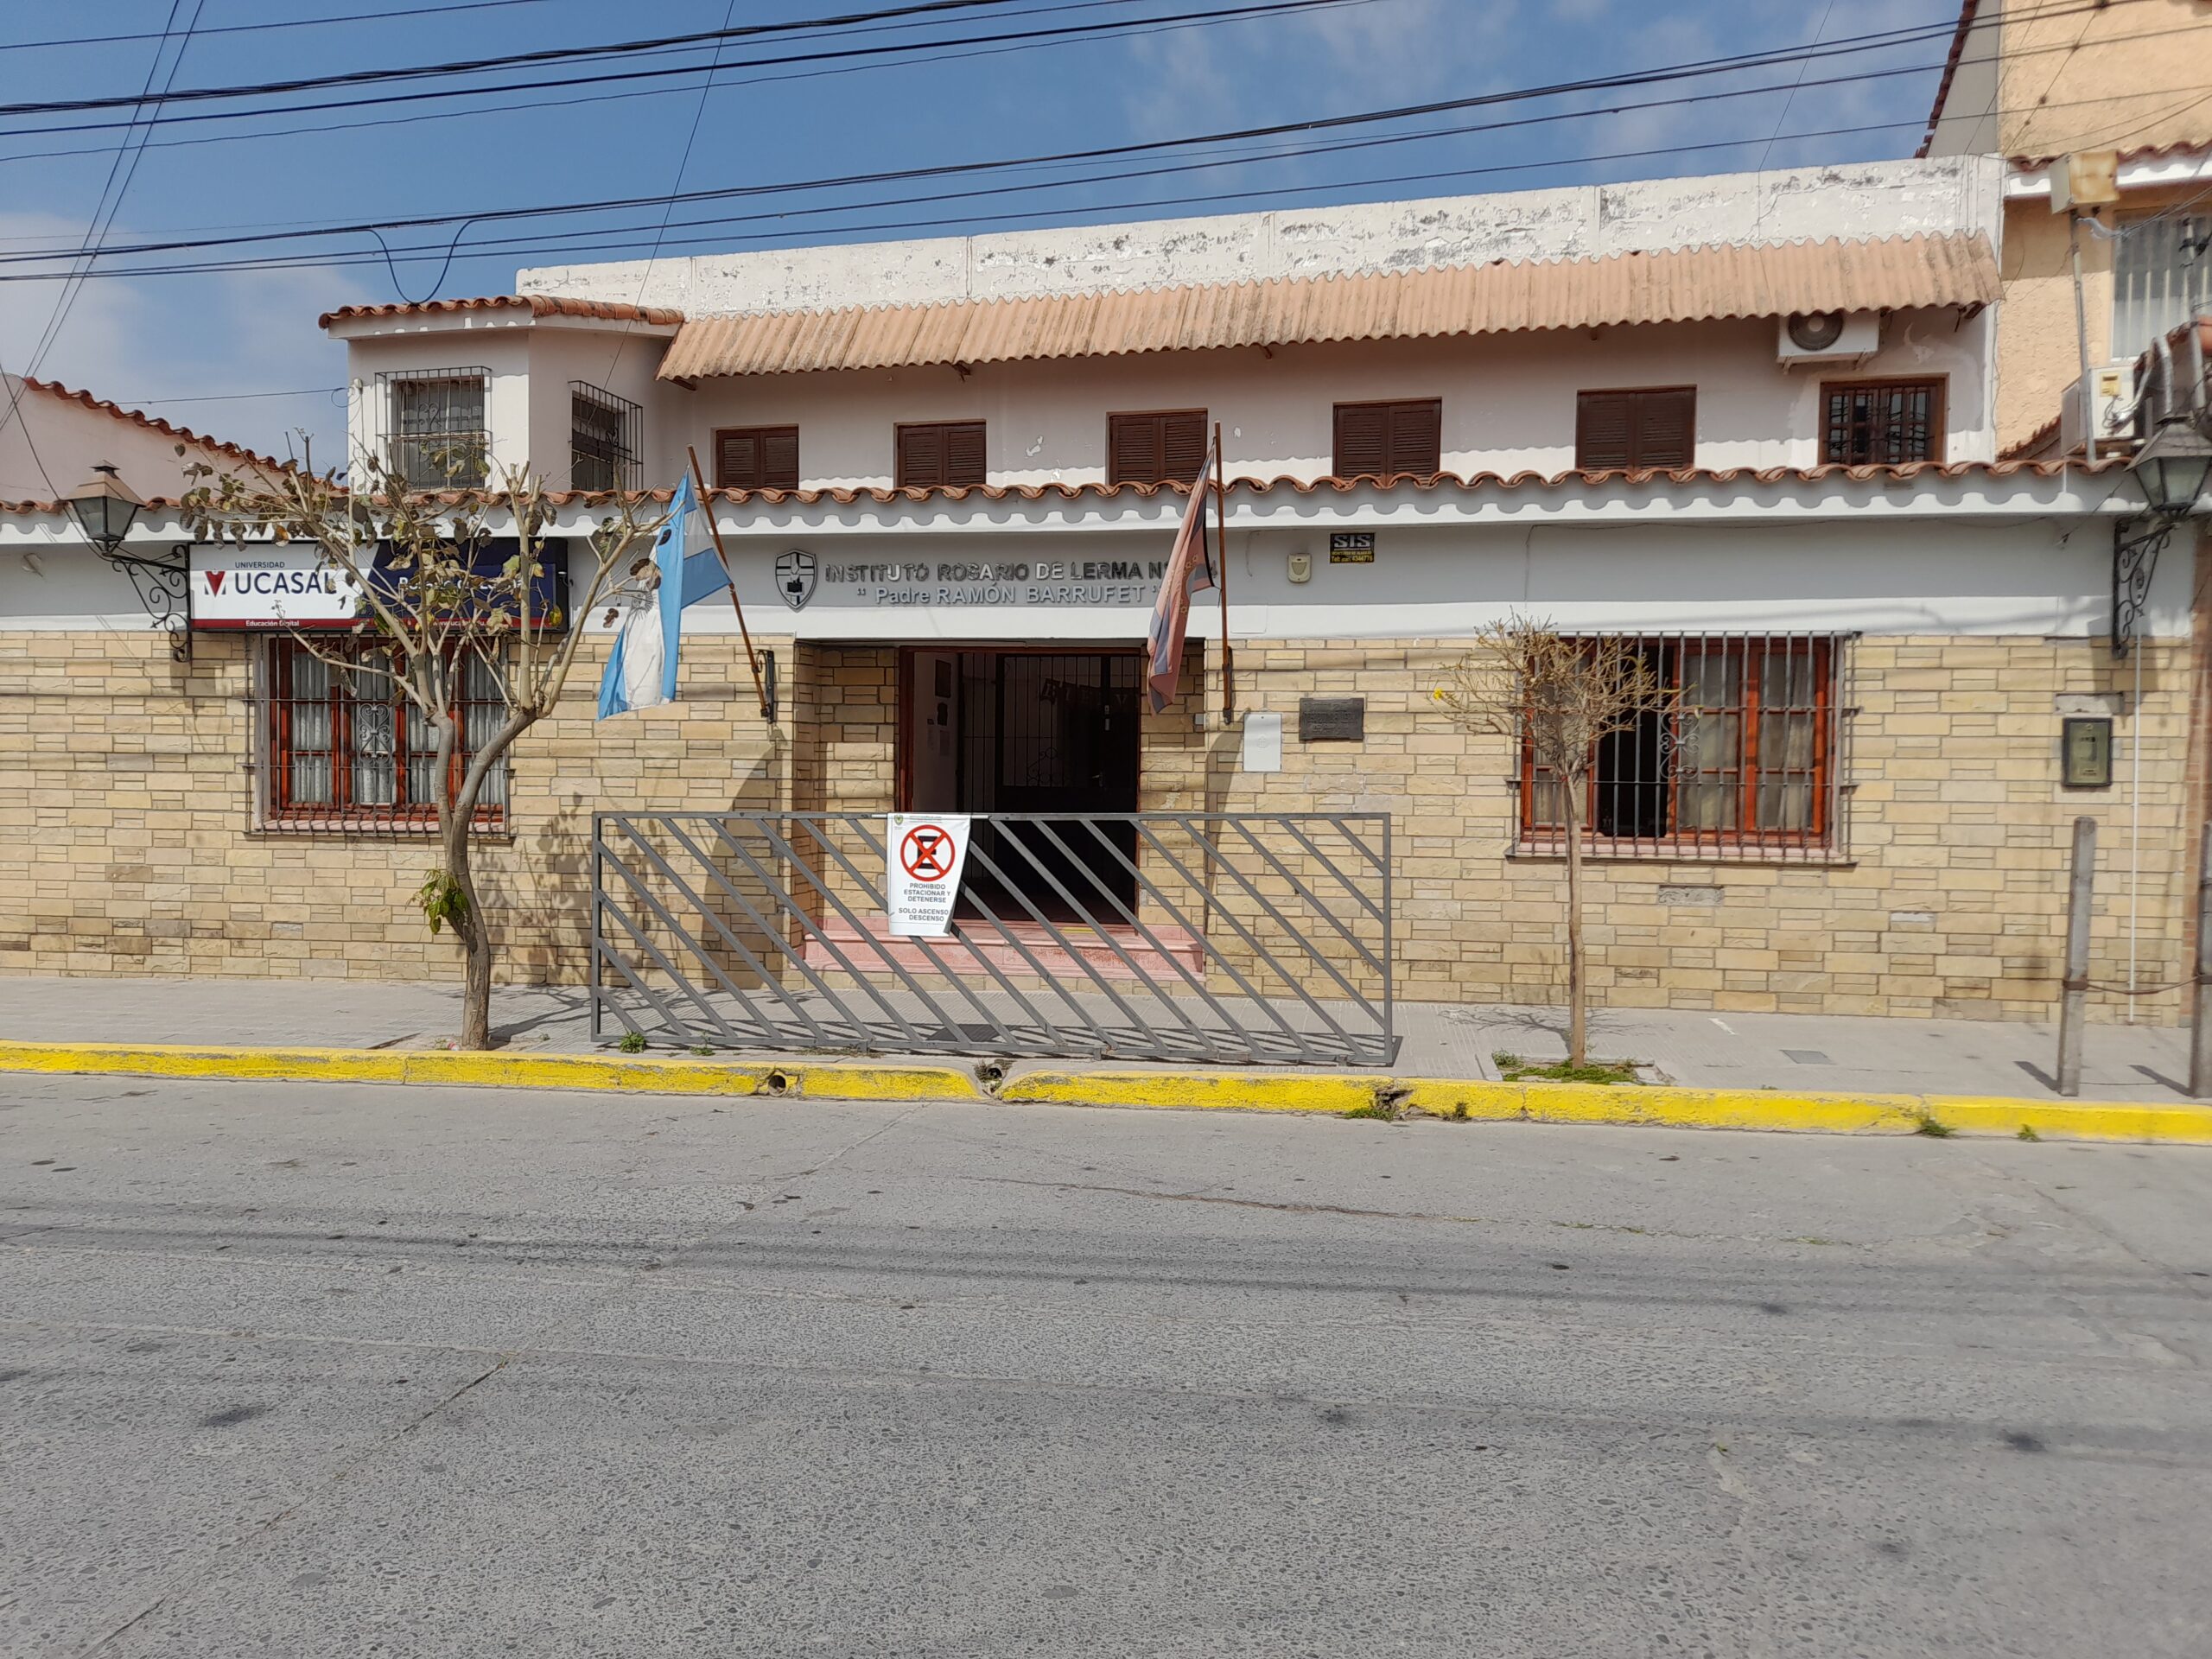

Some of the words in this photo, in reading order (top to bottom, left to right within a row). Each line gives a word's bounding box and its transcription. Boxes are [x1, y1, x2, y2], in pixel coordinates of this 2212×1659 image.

[1334, 534, 1370, 547] SIS
[235, 571, 337, 594] UCASAL
[825, 563, 929, 582] INSTITUTO
[937, 562, 1029, 582] ROSARIO
[1036, 562, 1064, 580] DE
[1070, 561, 1143, 581] LERMA
[875, 588, 930, 605] Padre
[936, 581, 1016, 605] RAMÓN
[1027, 585, 1146, 604] BARRUFET
